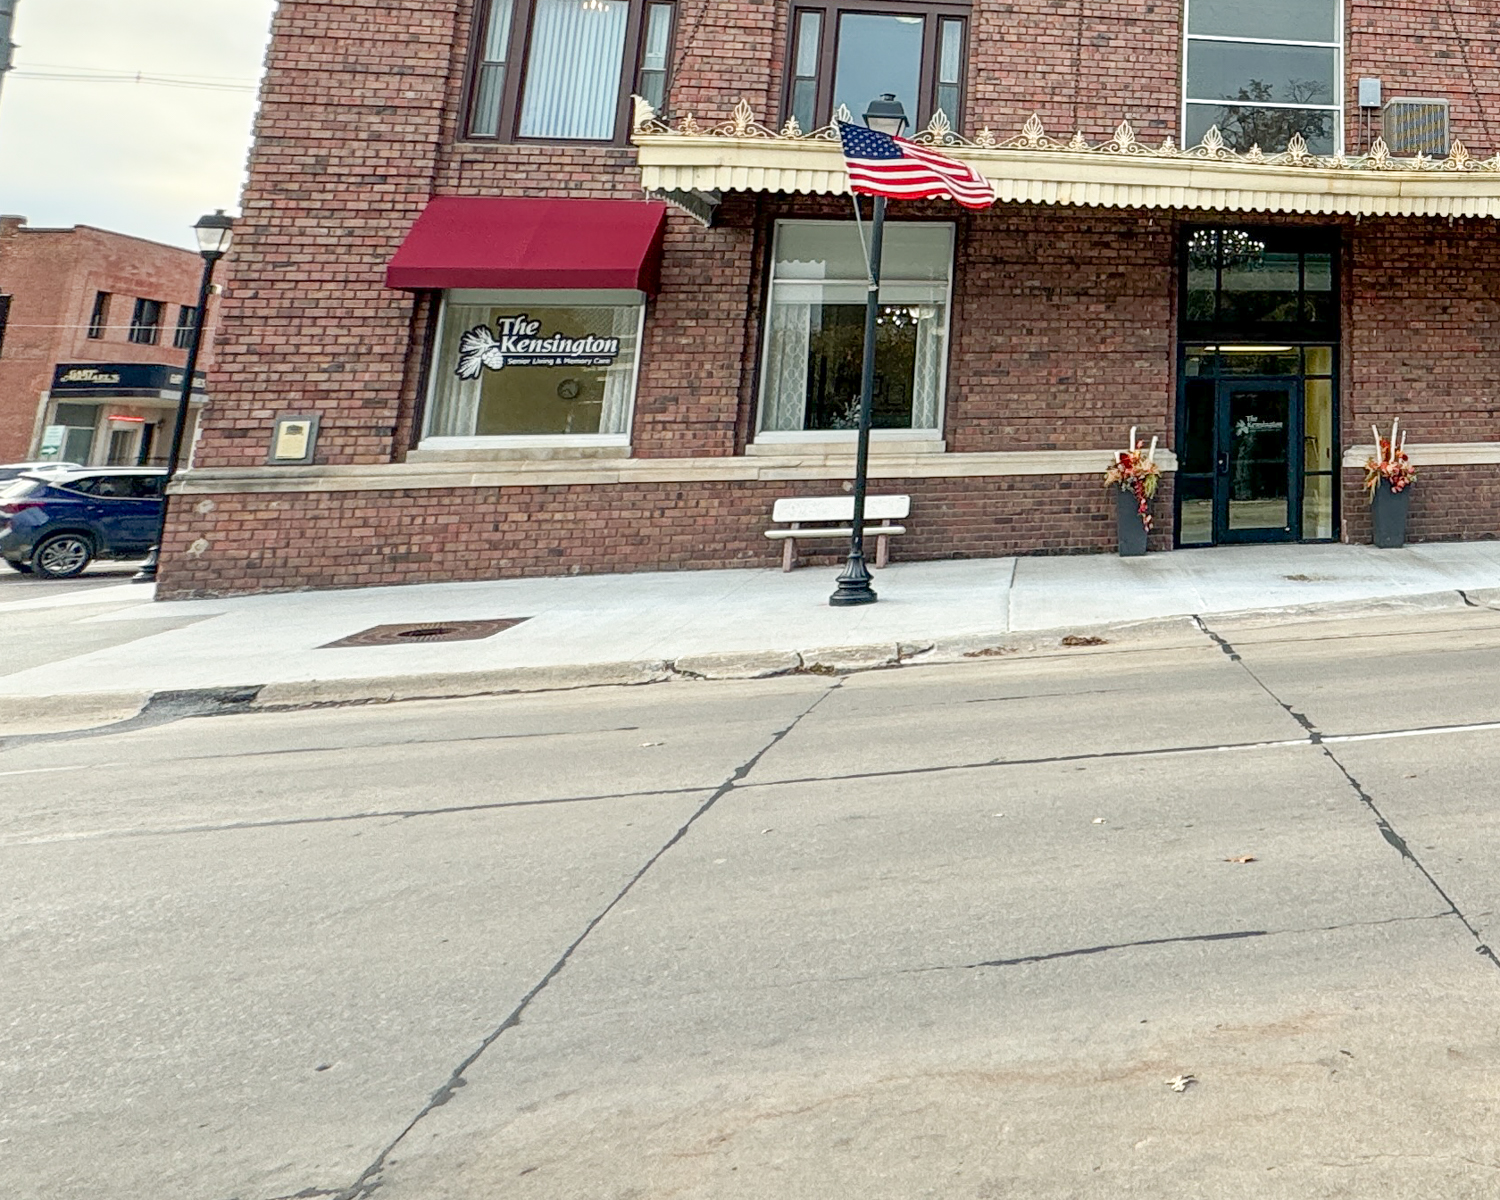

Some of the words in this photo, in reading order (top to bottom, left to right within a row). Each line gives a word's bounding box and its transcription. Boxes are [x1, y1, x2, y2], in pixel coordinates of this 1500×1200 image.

[498, 314, 540, 336] The
[501, 334, 620, 357] Kensington
[532, 358, 555, 366] Living
[563, 358, 593, 366] Memory
